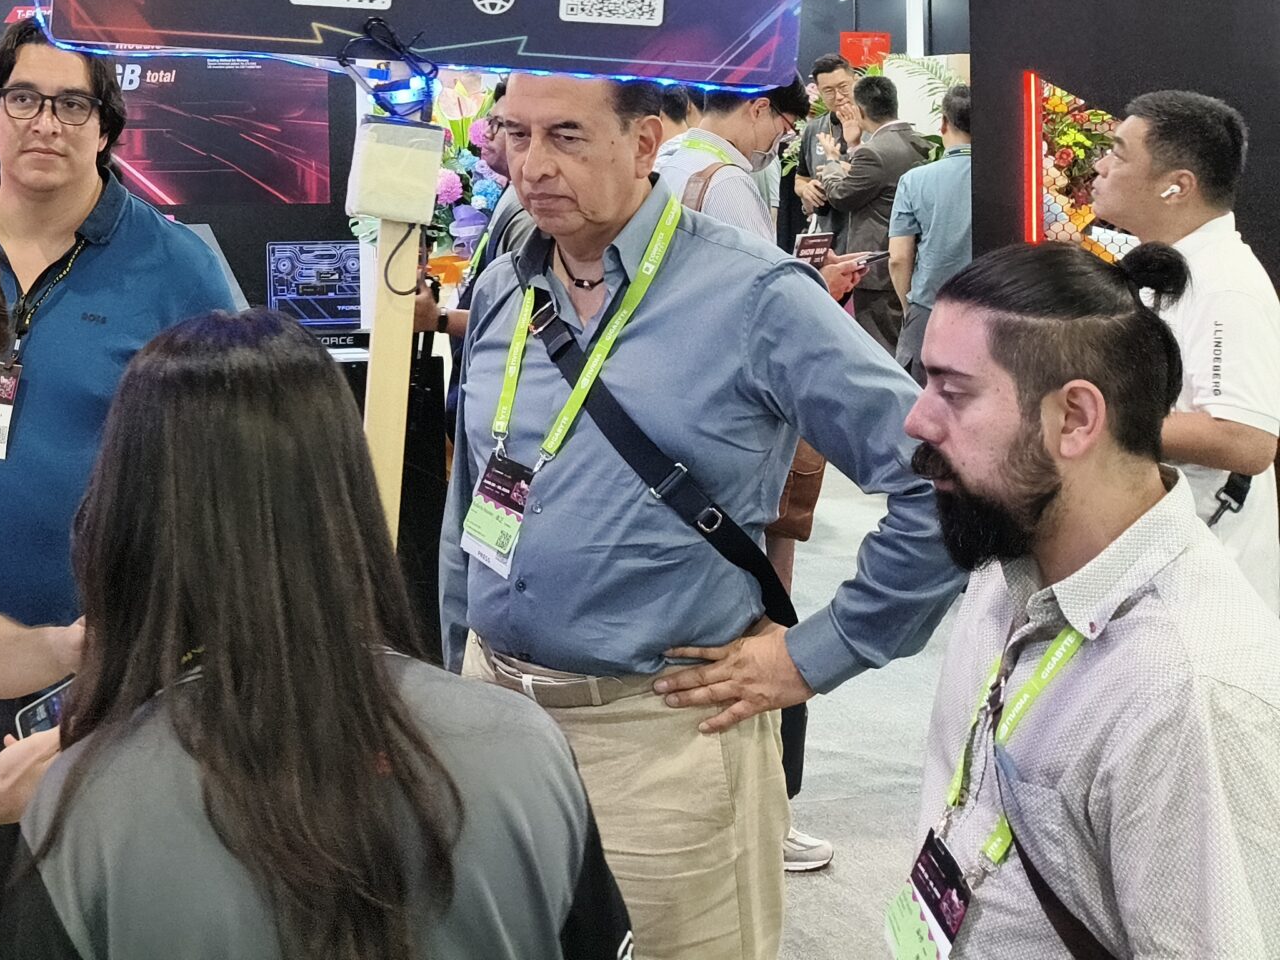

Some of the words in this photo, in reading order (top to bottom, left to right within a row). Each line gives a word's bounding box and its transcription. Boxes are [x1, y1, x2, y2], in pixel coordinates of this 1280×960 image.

[146, 70, 176, 83] total
[1005, 692, 1030, 726] NVIDIA
[1040, 634, 1077, 681] GIGABYTE
